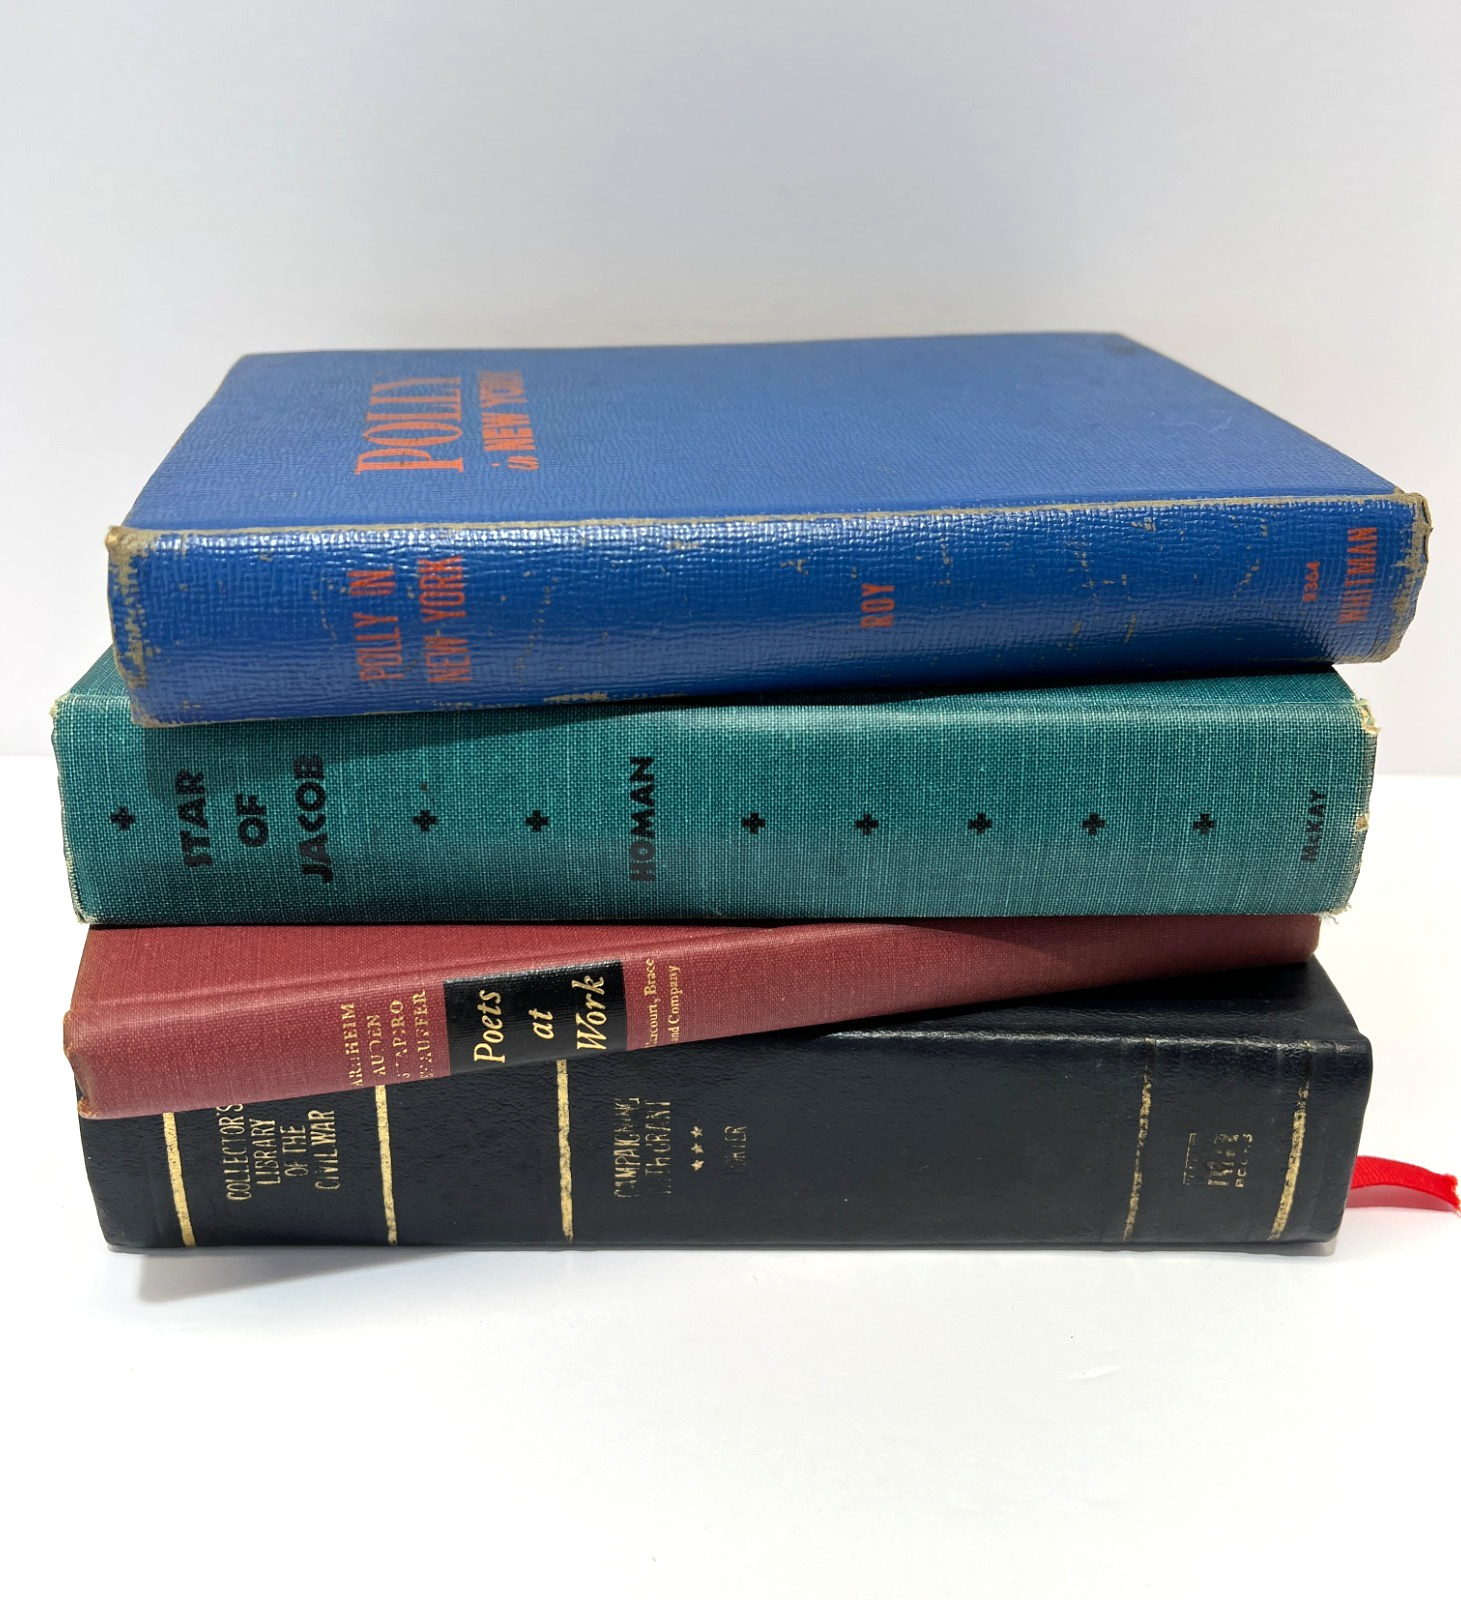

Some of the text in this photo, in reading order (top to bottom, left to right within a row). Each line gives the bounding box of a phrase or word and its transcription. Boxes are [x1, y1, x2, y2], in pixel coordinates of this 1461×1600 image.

[354, 376, 464, 475] POLLY
[481, 412, 537, 452] NEW
[491, 455, 540, 471] in
[860, 583, 896, 628] ROY
[1336, 527, 1378, 625] WHITMAN
[347, 569, 405, 681] POLLY IN
[416, 554, 473, 683] NEW YORK
[176, 768, 213, 868] STAR
[234, 793, 269, 848] OF
[293, 754, 334, 884] JACOB
[629, 755, 656, 882] HOMAN
[571, 974, 608, 1050] Work
[644, 957, 660, 997] Brace
[668, 964, 684, 1025] Company
[340, 1002, 363, 1087] ARHEIM
[473, 989, 506, 1064] Poets
[528, 1007, 555, 1040] at
[248, 1118, 281, 1185] LIBRARY
[279, 1124, 309, 1177] OF THE
[307, 1109, 341, 1190] CIVIL WAR
